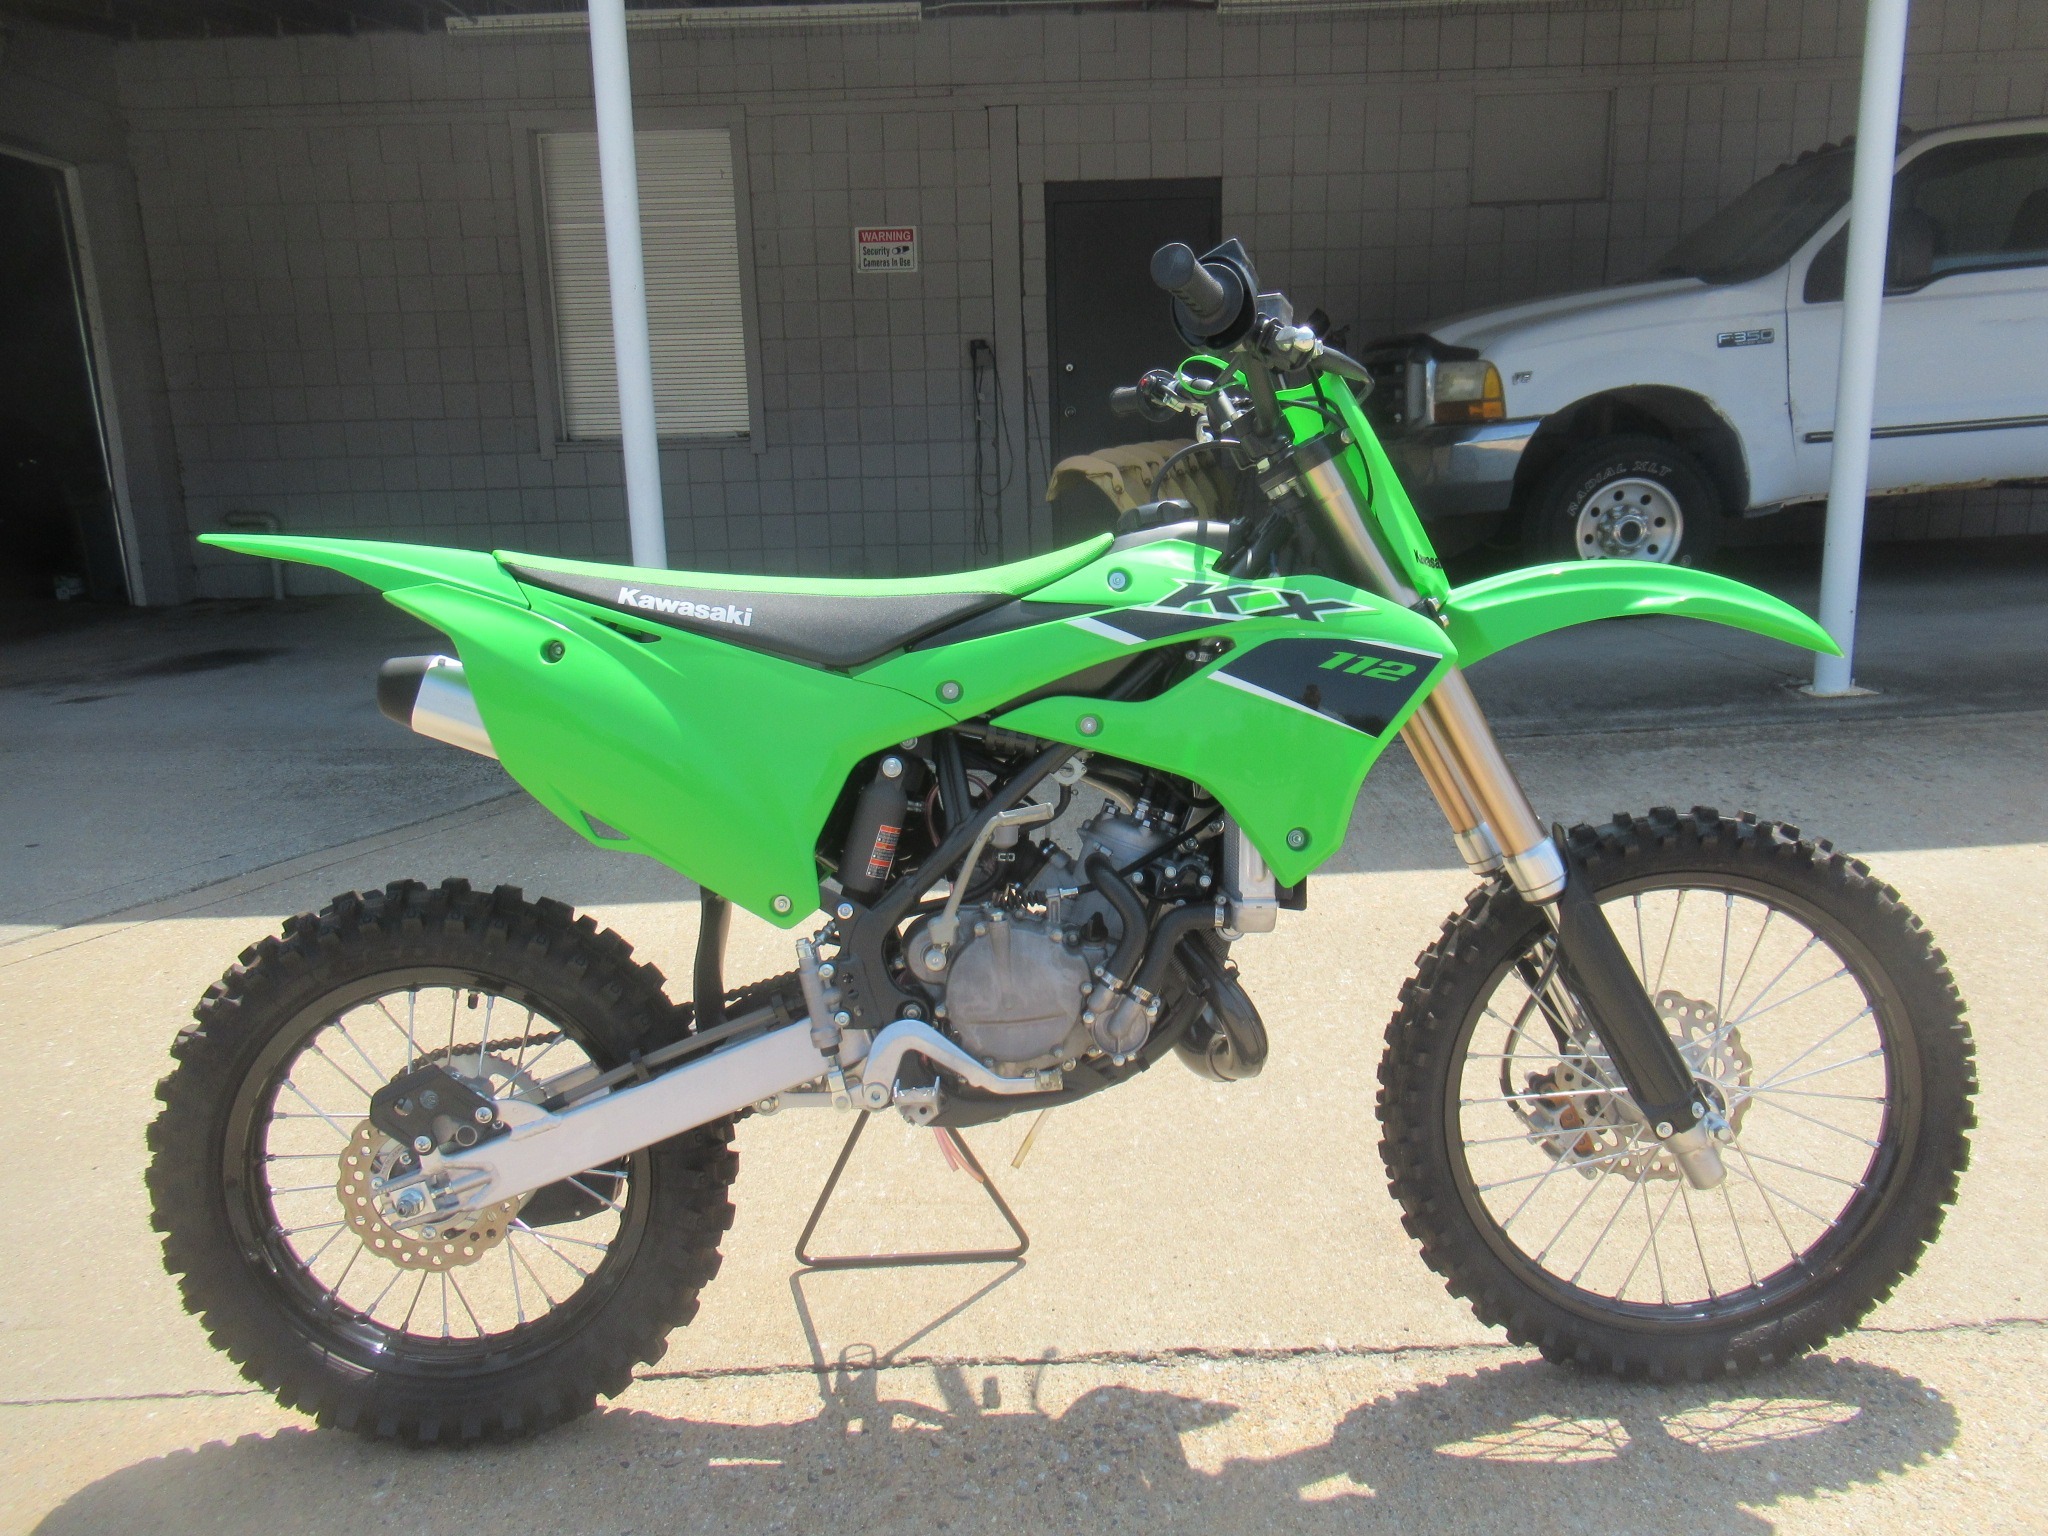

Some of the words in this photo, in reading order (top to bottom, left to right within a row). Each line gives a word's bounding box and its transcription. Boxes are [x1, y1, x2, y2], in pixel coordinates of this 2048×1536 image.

[861, 231, 912, 242] WARNING
[862, 246, 890, 257] Security
[863, 258, 890, 268] Cameras
[892, 258, 898, 267] In
[900, 257, 911, 267] Use
[1566, 463, 1627, 517] RADIAL
[1632, 460, 1673, 477] XLT
[617, 586, 753, 627] Kawasaki
[1149, 577, 1380, 623] KX
[1317, 651, 1418, 682] 112
